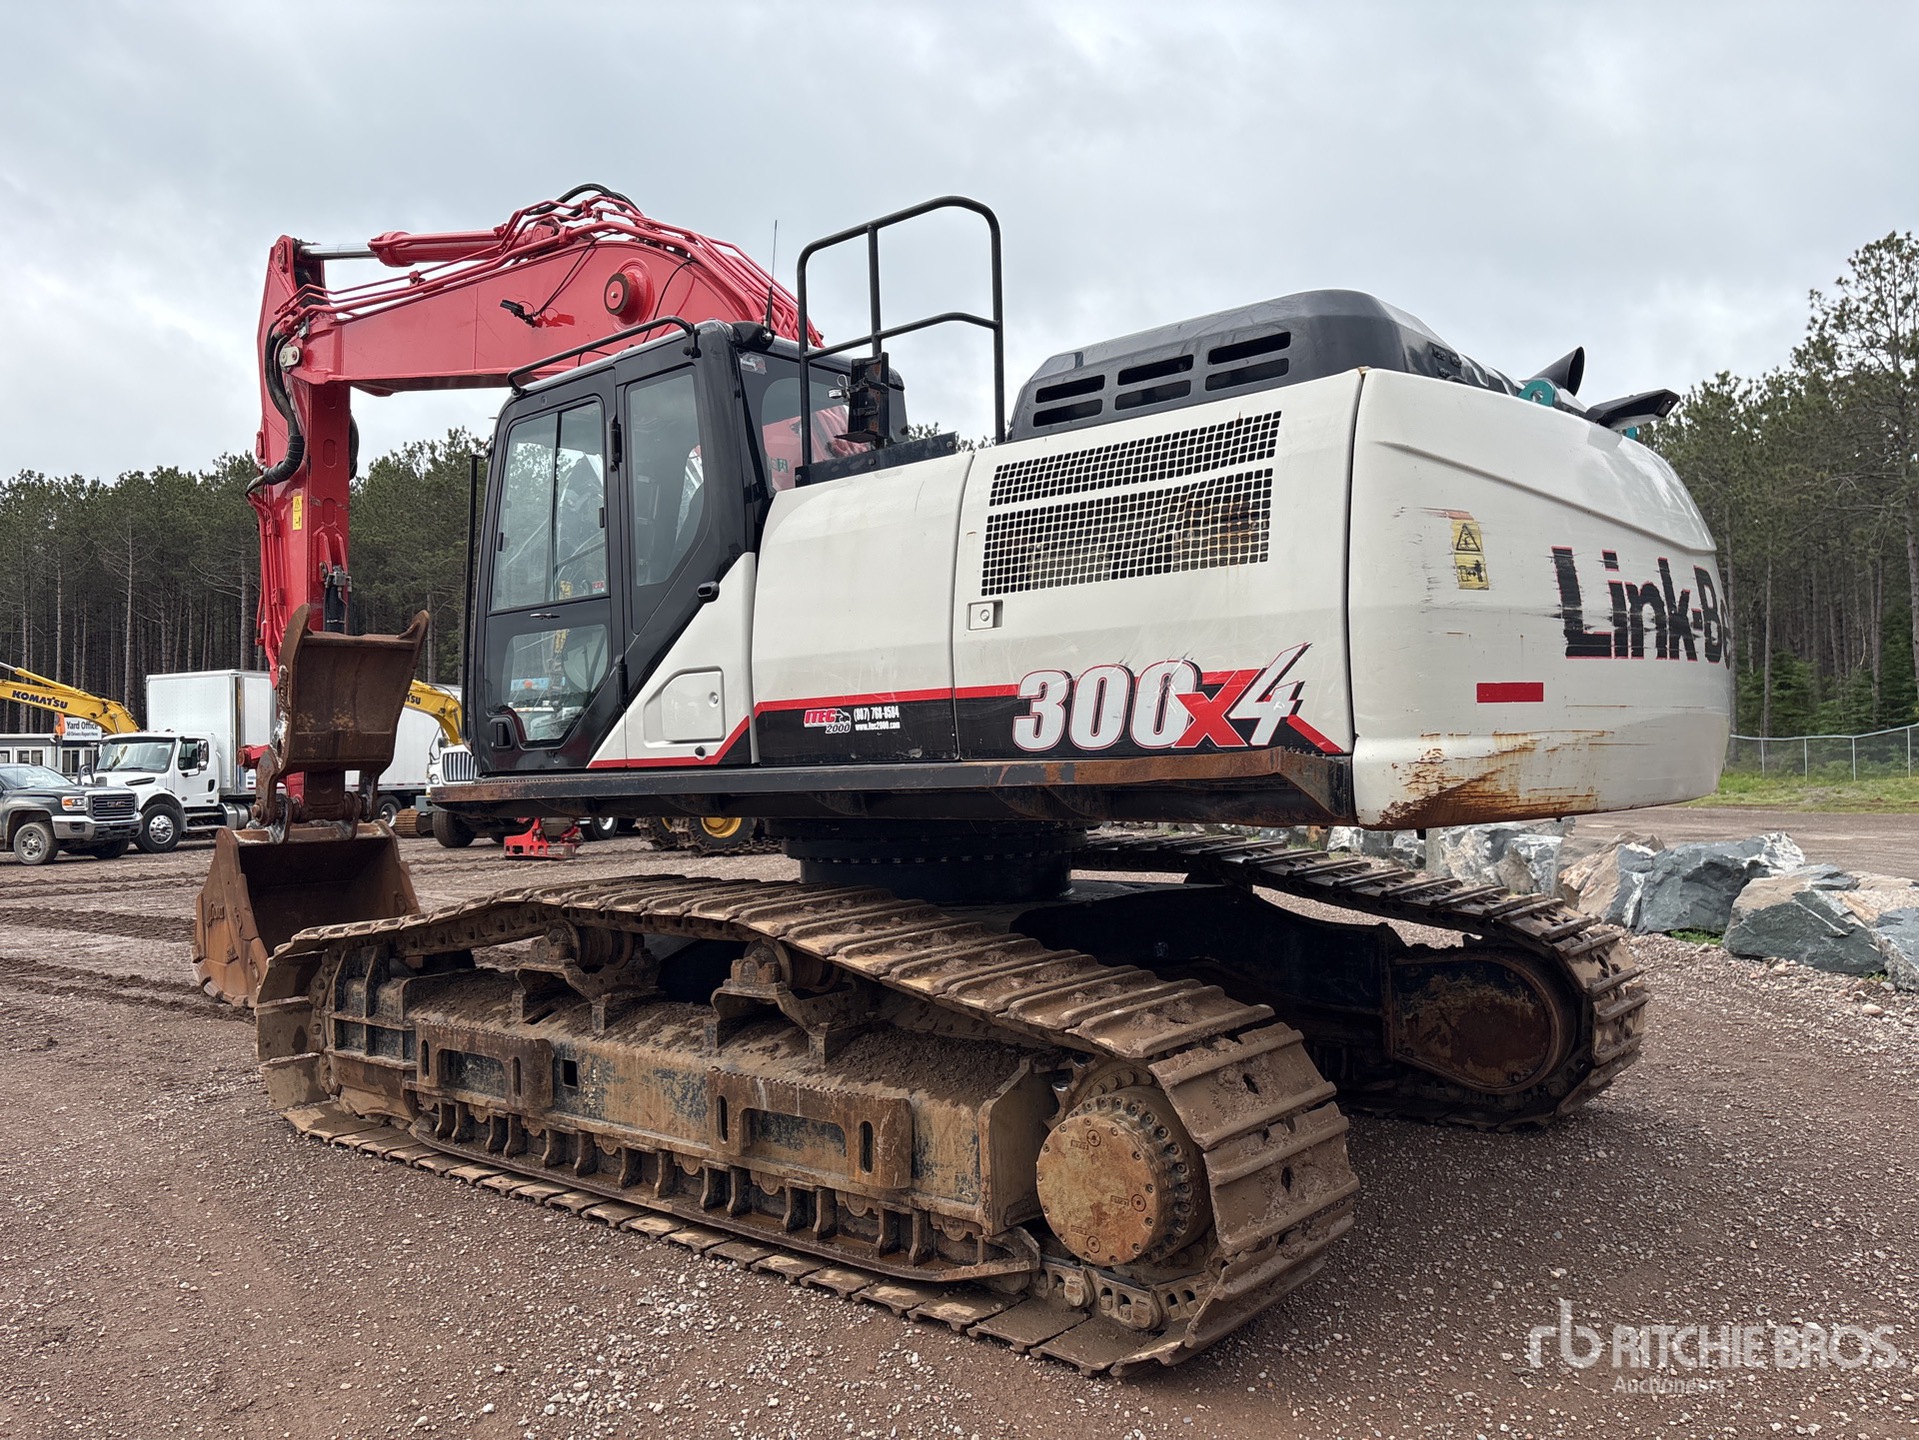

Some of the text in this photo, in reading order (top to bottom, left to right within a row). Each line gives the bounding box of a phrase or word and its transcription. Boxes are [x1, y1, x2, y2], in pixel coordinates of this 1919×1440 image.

[12, 690, 68, 709] KOMATSU
[804, 708, 837, 724] ITEC
[66, 720, 98, 730] Yard Office
[826, 723, 850, 733] 2000
